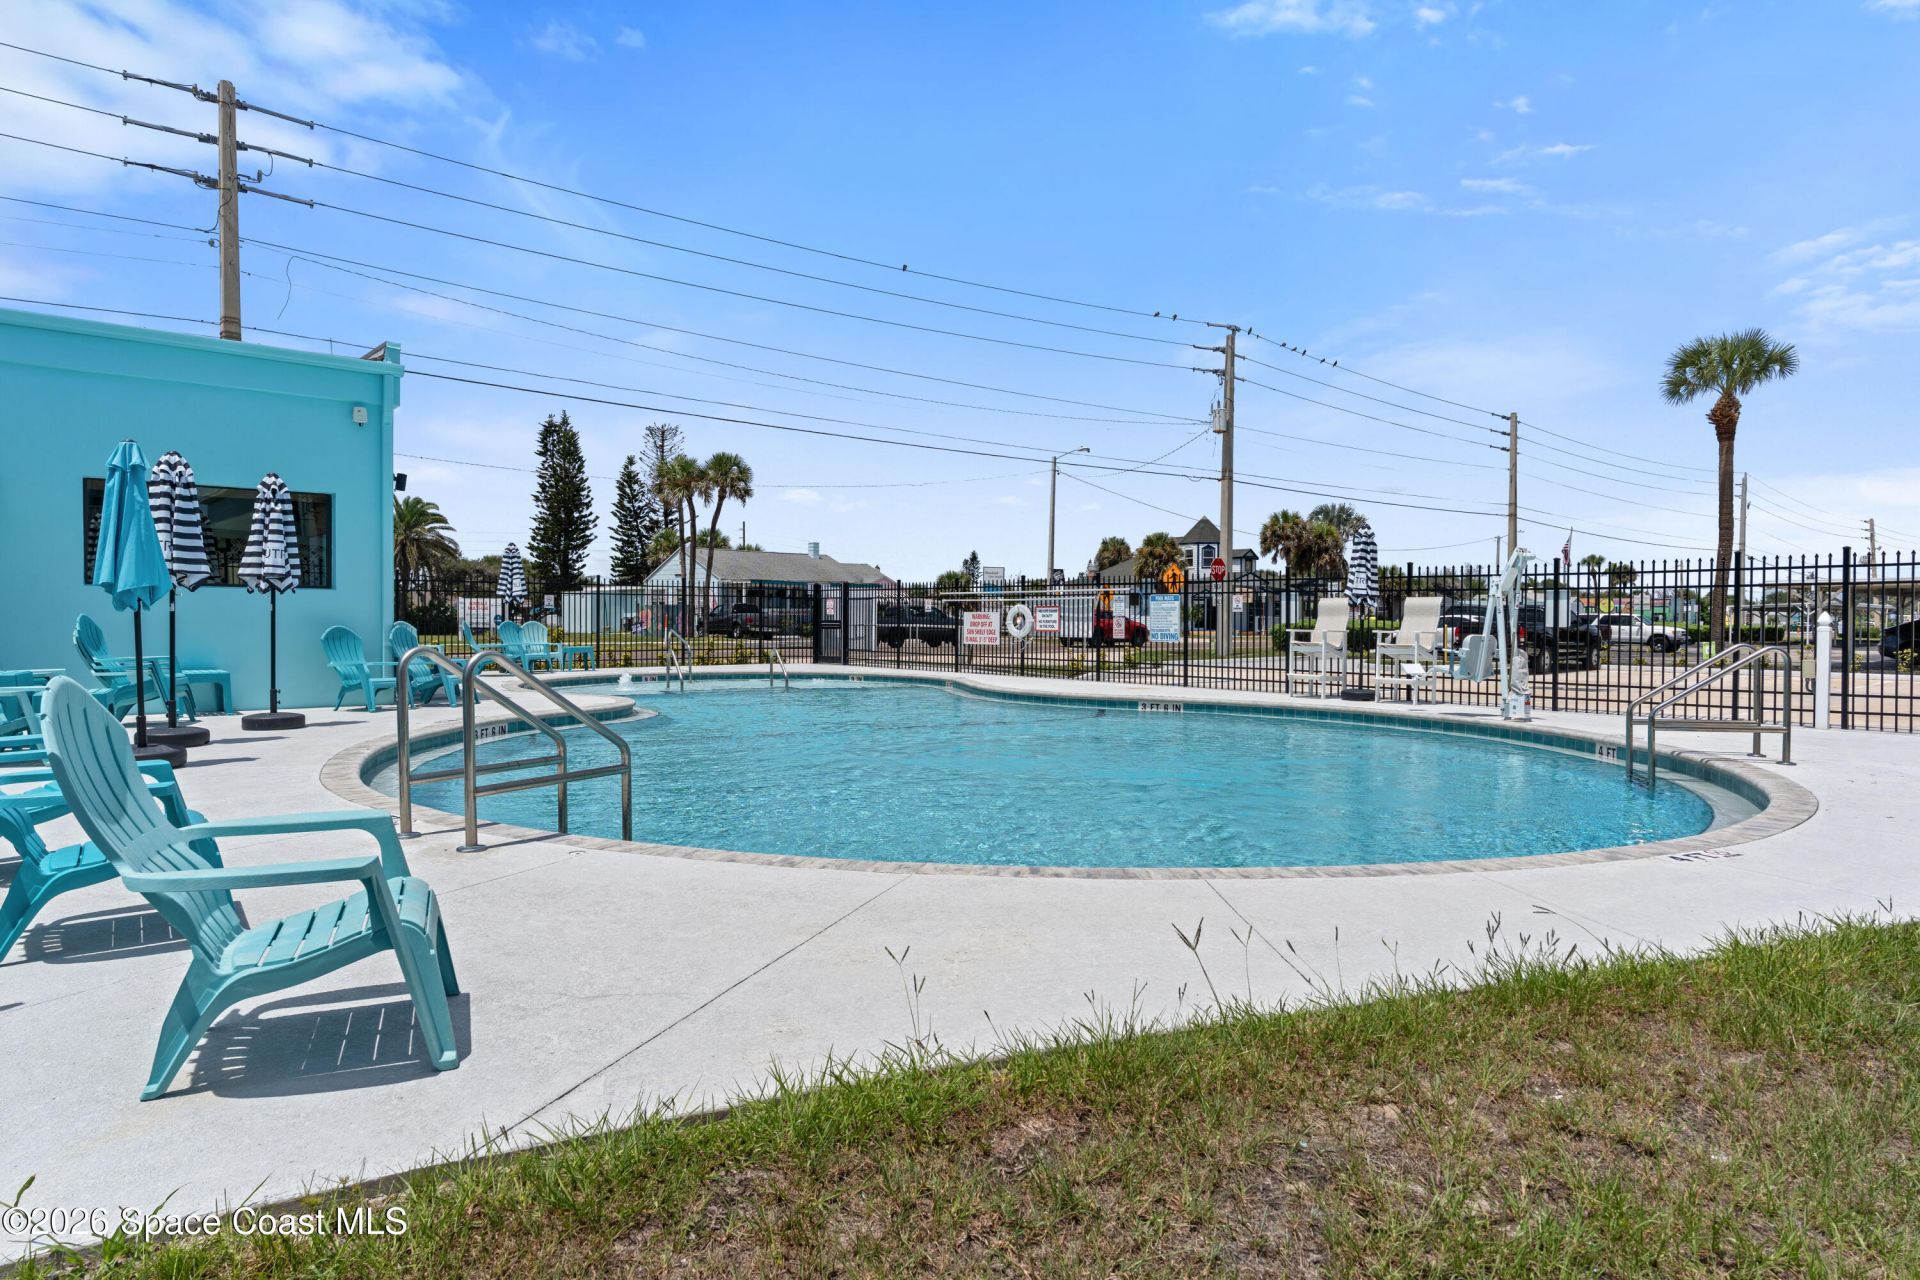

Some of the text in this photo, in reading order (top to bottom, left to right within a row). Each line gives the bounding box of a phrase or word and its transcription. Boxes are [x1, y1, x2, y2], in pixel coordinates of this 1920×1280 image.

[1212, 565, 1225, 574] STOP
[1141, 702, 1181, 711] 3 FT 6 IN
[480, 727, 488, 739] FT
[491, 726, 496, 737] 6
[498, 724, 506, 735] IN
[1598, 745, 1616, 759] 4 FT
